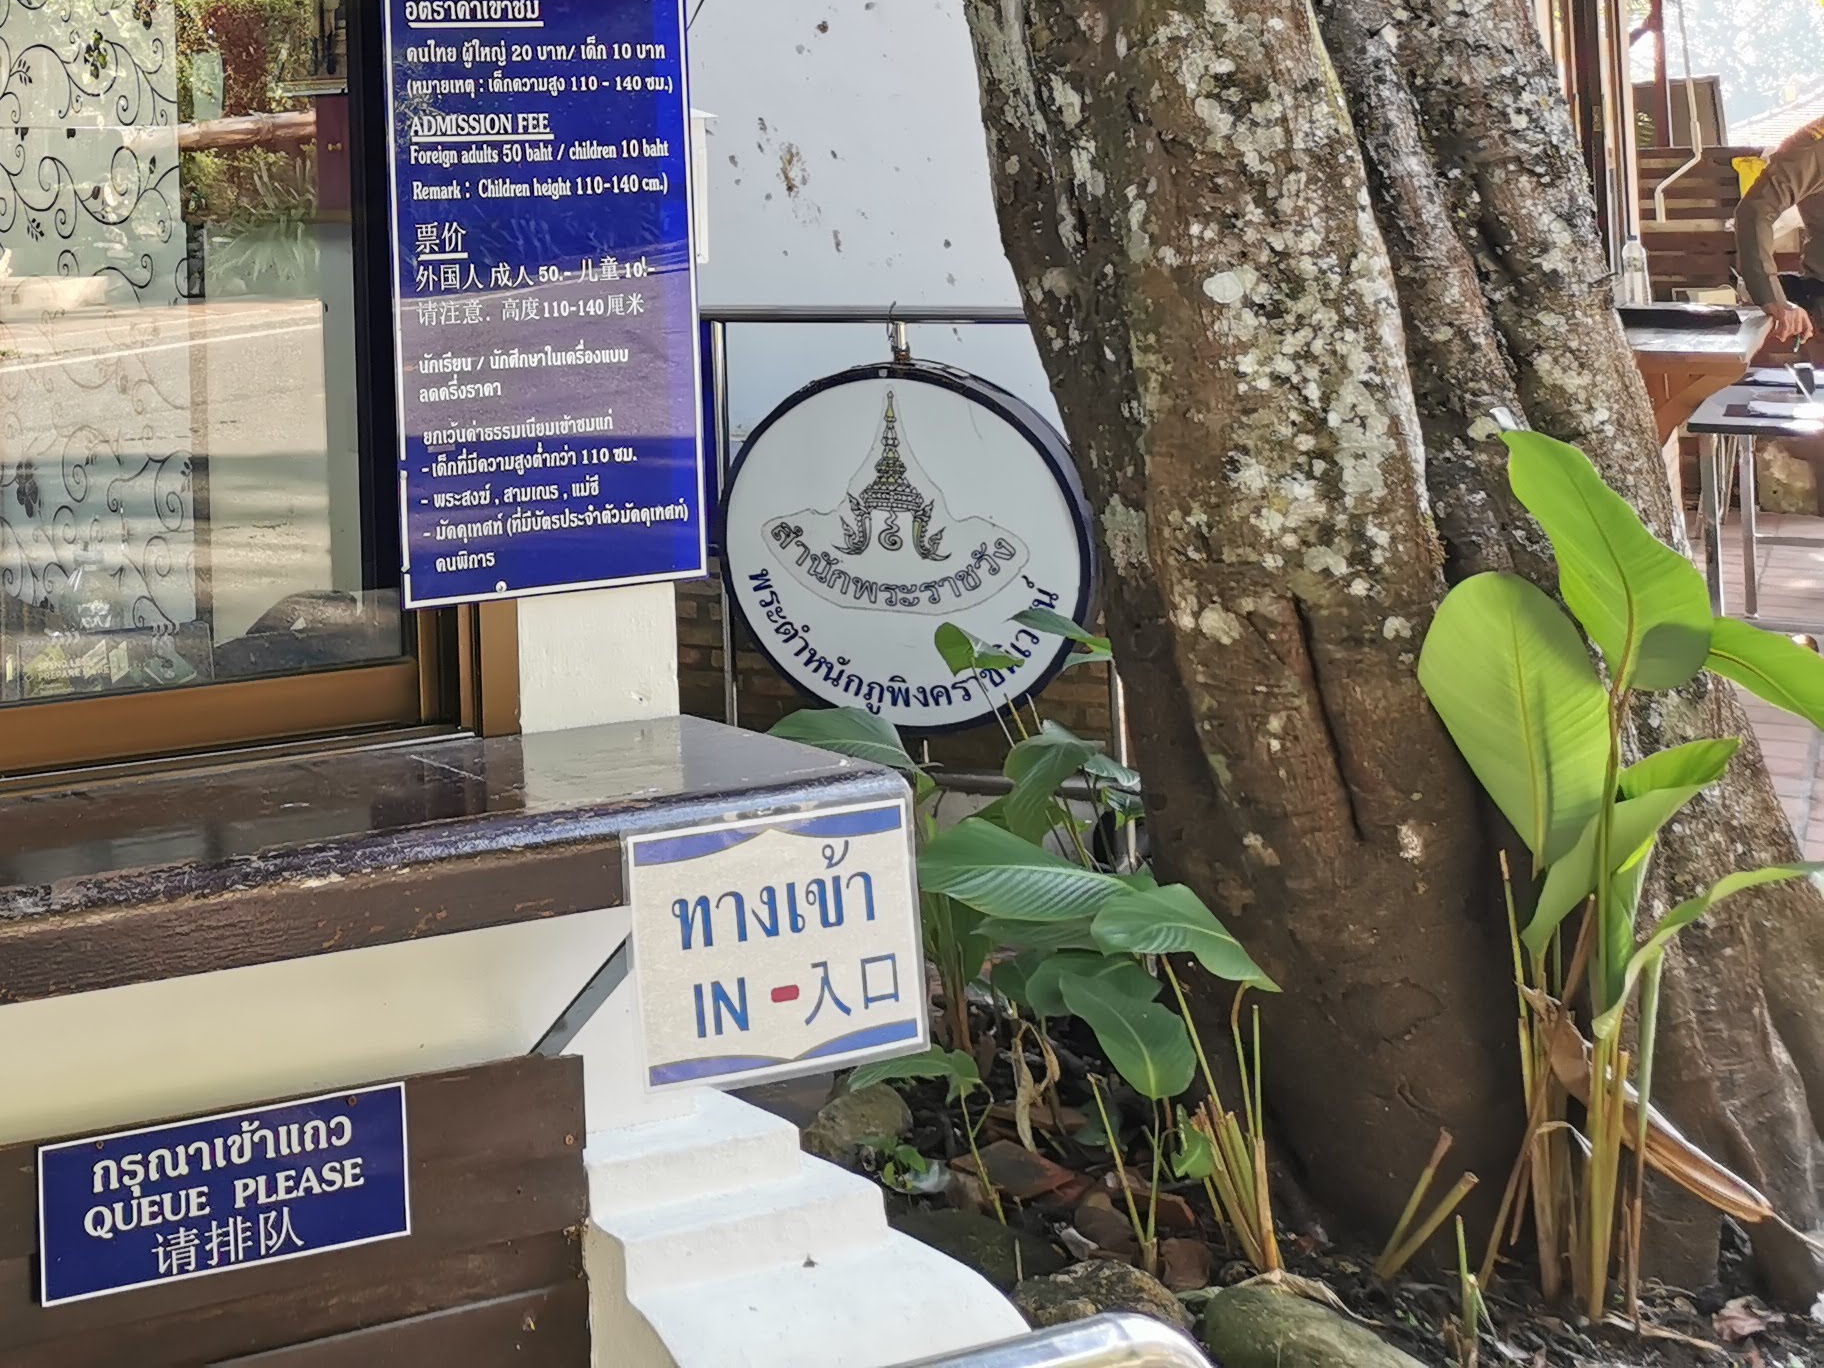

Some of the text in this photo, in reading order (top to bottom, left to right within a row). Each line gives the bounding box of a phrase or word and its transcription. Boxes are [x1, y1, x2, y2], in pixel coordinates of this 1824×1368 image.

[406, 40, 457, 63] คนไทย
[461, 39, 507, 68] ผู้ใหญ่
[511, 46, 533, 61] 20
[580, 36, 607, 60] เด็ก
[613, 43, 632, 59] 10
[636, 43, 666, 60] บาท
[488, 70, 566, 96] เด็กความสูง
[571, 76, 598, 91] 110
[615, 76, 641, 91] 140
[410, 113, 551, 136] ADMISSION FEE
[410, 139, 669, 168] Foreign adults 50 baht children 10 baht
[412, 181, 462, 200] Remark
[479, 178, 530, 199] Children
[533, 178, 571, 200] height
[576, 174, 639, 195] 110-140
[415, 222, 467, 254] 票价
[415, 264, 484, 292] 外国人
[489, 262, 534, 288] 成人
[578, 257, 620, 283] 儿童
[419, 339, 629, 374] นักเรียน นักศึกษาในเครื่องแบบ
[419, 374, 502, 403] ลดครึ่งราคา
[423, 409, 614, 446] ยกเว้นค่าธรรมเนียมเข้าชมแก่
[582, 448, 609, 464] 110
[434, 474, 600, 509] พระสงฆ์ สามเณร แม่ชี
[435, 551, 496, 573] คนพิการ
[771, 521, 1017, 608] สำนักพระราชวัง
[671, 840, 877, 951] ทางเข้า
[693, 953, 901, 1039] IN 入口
[91, 1113, 353, 1200] กรุณาเข้าแถว
[83, 1158, 364, 1240] QUEUE PLEASE
[151, 1205, 304, 1277] 请排队
